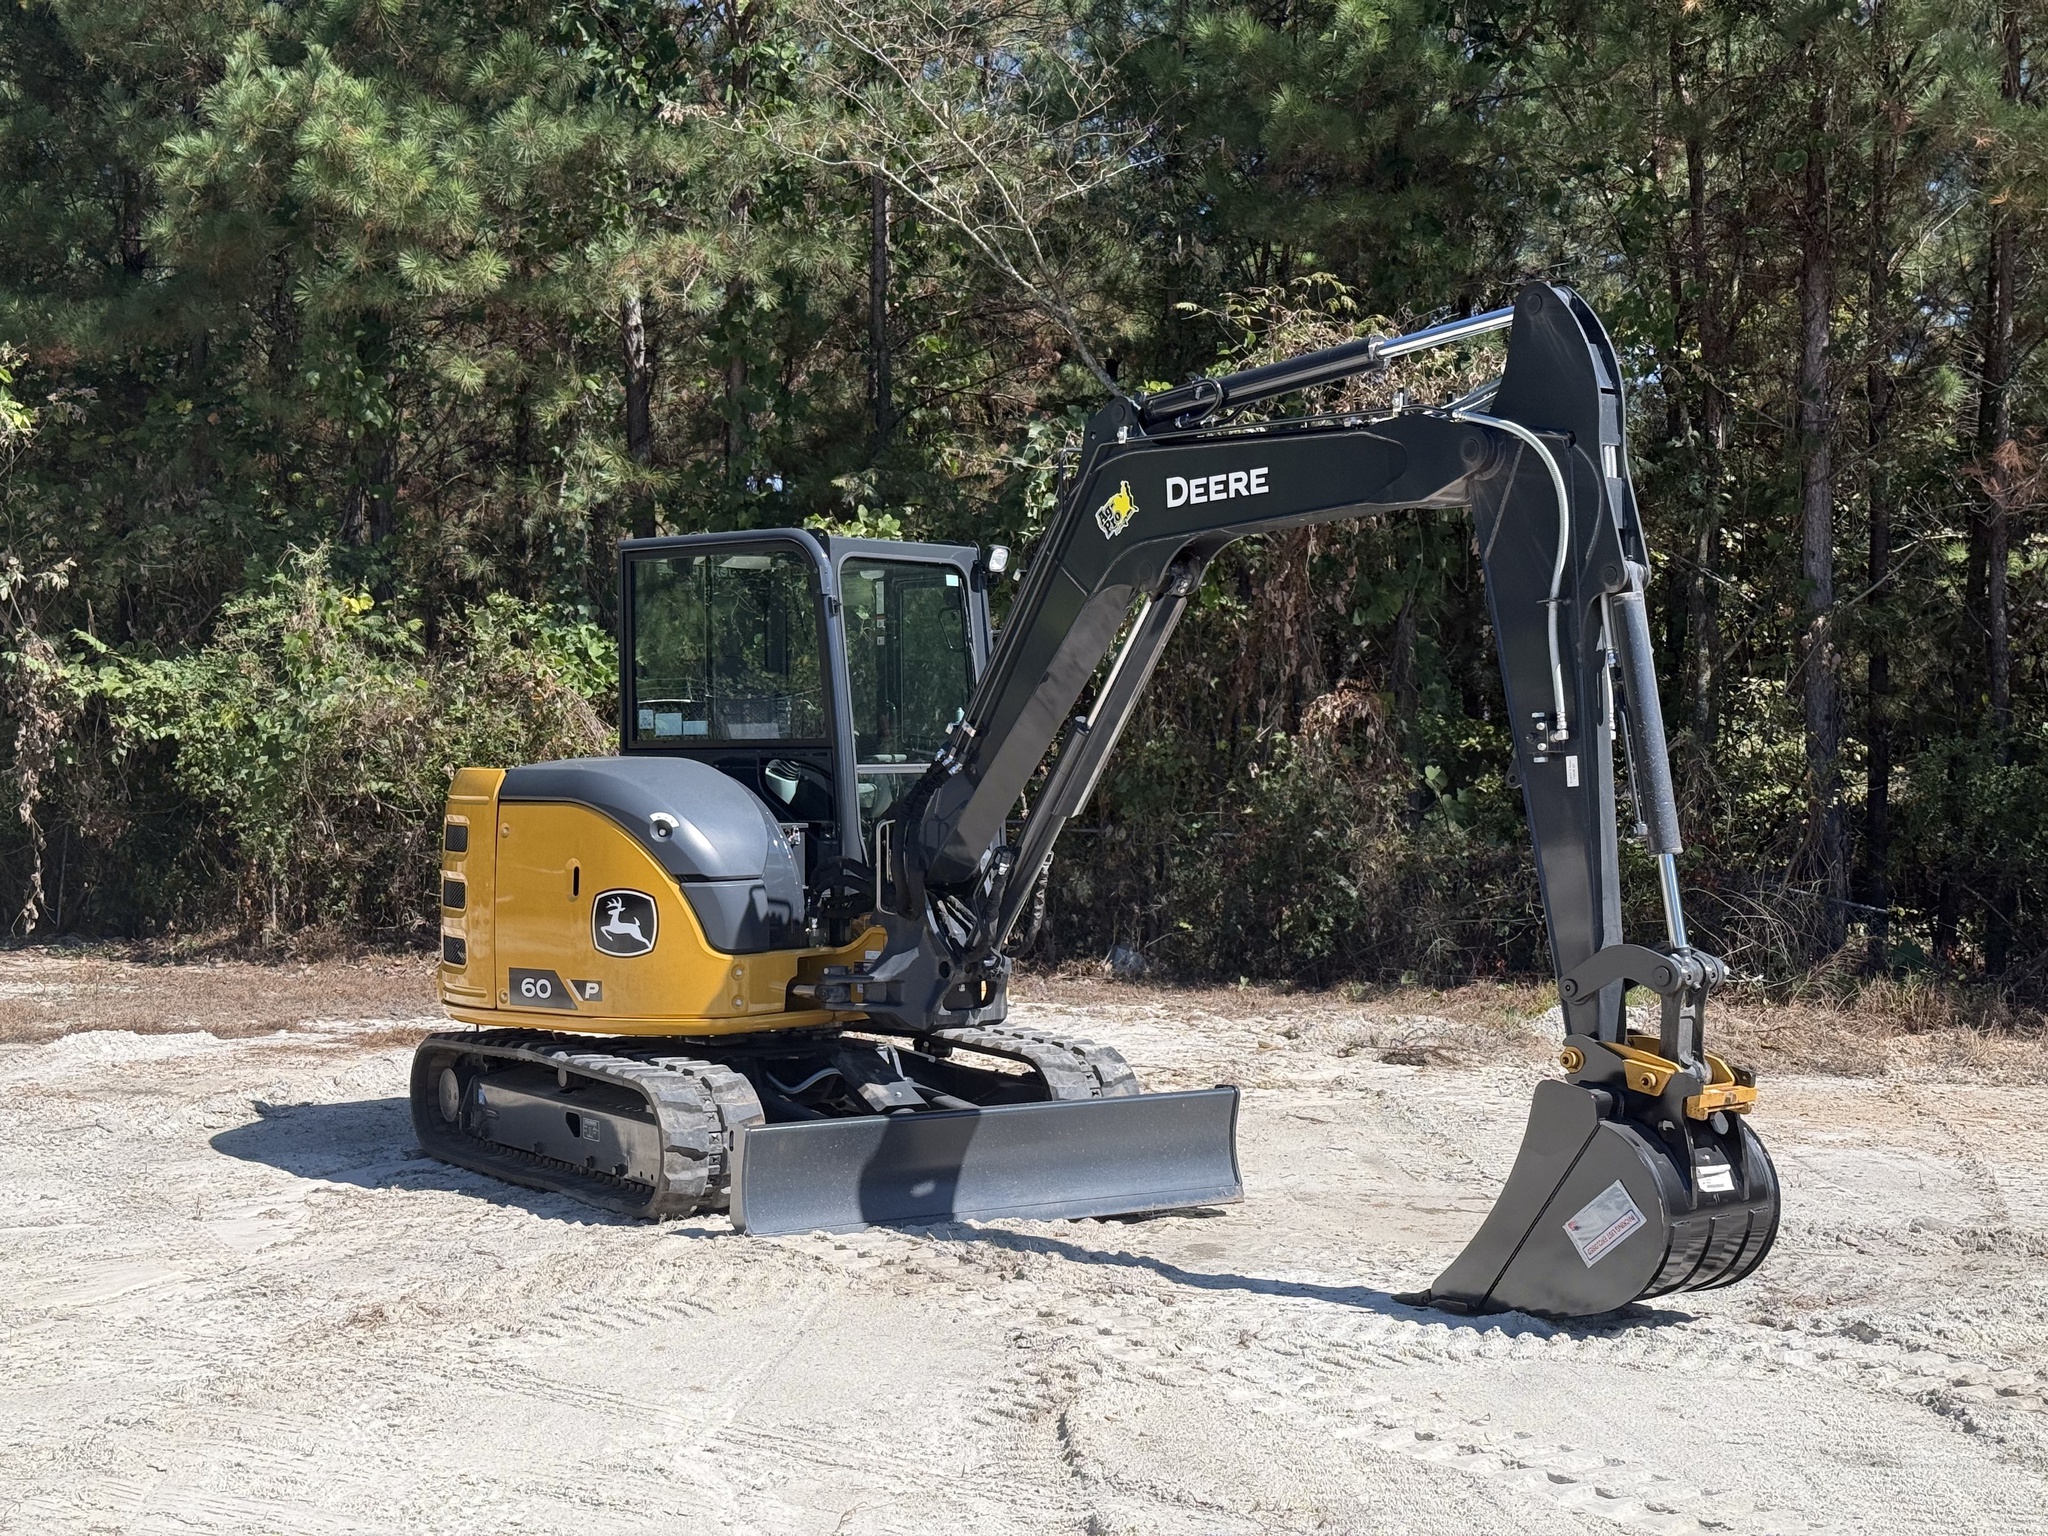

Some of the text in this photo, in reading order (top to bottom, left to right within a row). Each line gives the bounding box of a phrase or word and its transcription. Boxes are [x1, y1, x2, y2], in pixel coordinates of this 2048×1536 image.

[1166, 467, 1269, 508] DEERE
[1103, 511, 1121, 533] Pro
[521, 978, 600, 999] 60 P
[1606, 1228, 1617, 1240] LIST
[1615, 1214, 1635, 1233] PACKING
